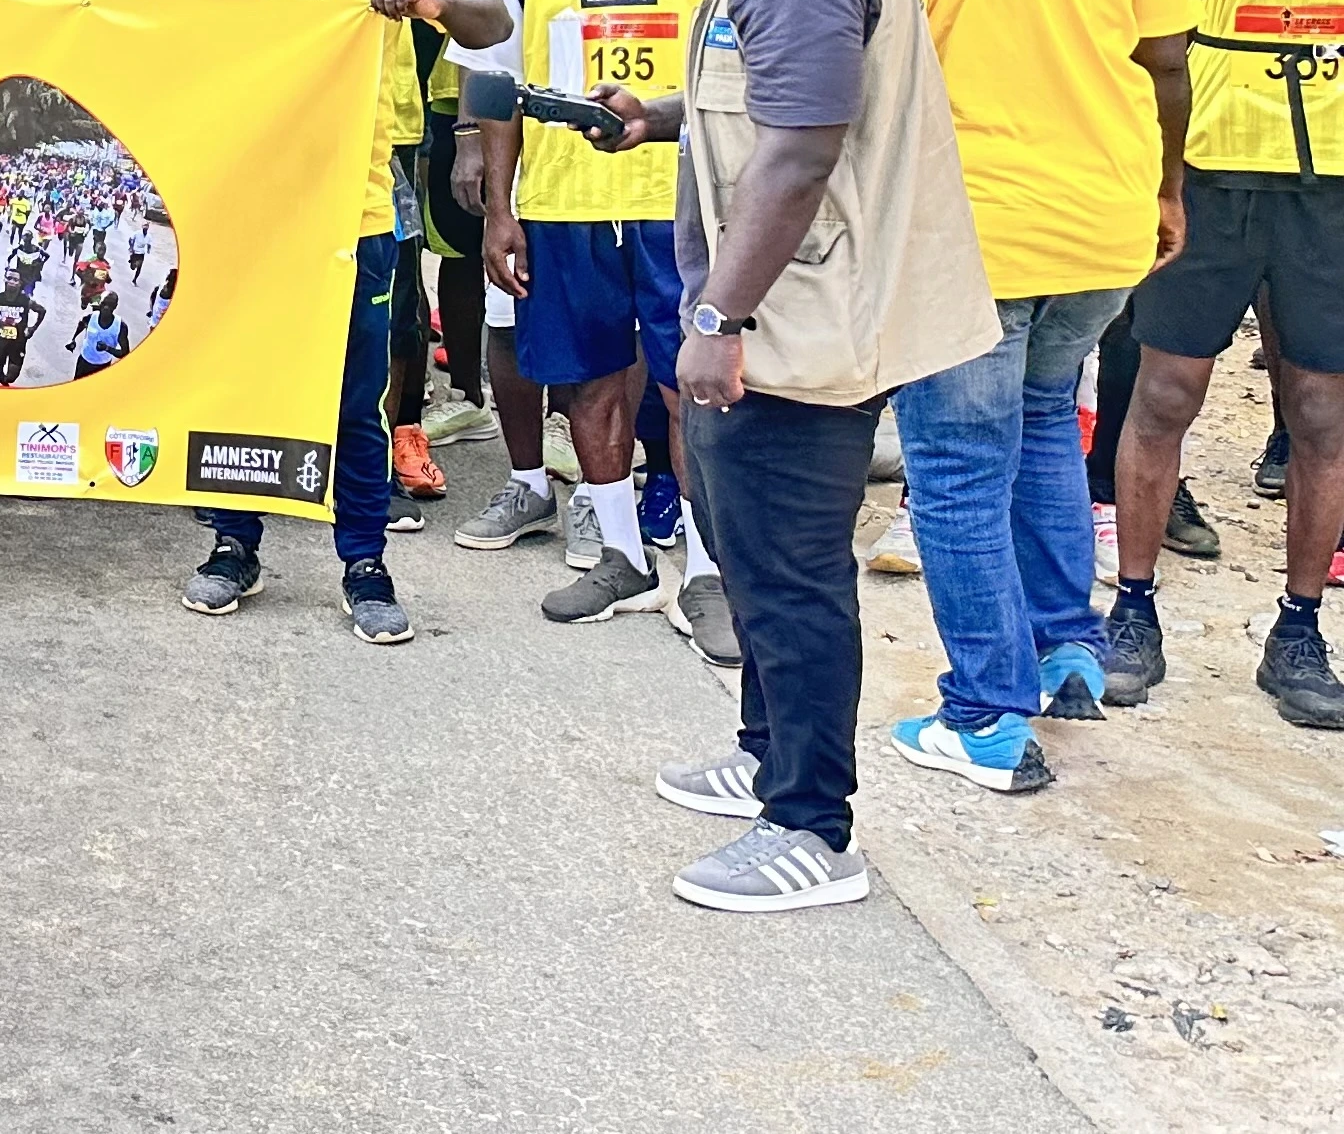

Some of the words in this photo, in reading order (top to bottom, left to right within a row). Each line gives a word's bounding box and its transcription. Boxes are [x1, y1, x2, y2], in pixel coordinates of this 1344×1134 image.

[591, 46, 655, 81] 135
[111, 444, 121, 455] F
[144, 446, 155, 461] A
[201, 444, 284, 469] AMNESTY
[201, 465, 282, 485] INTERNATIONAL
